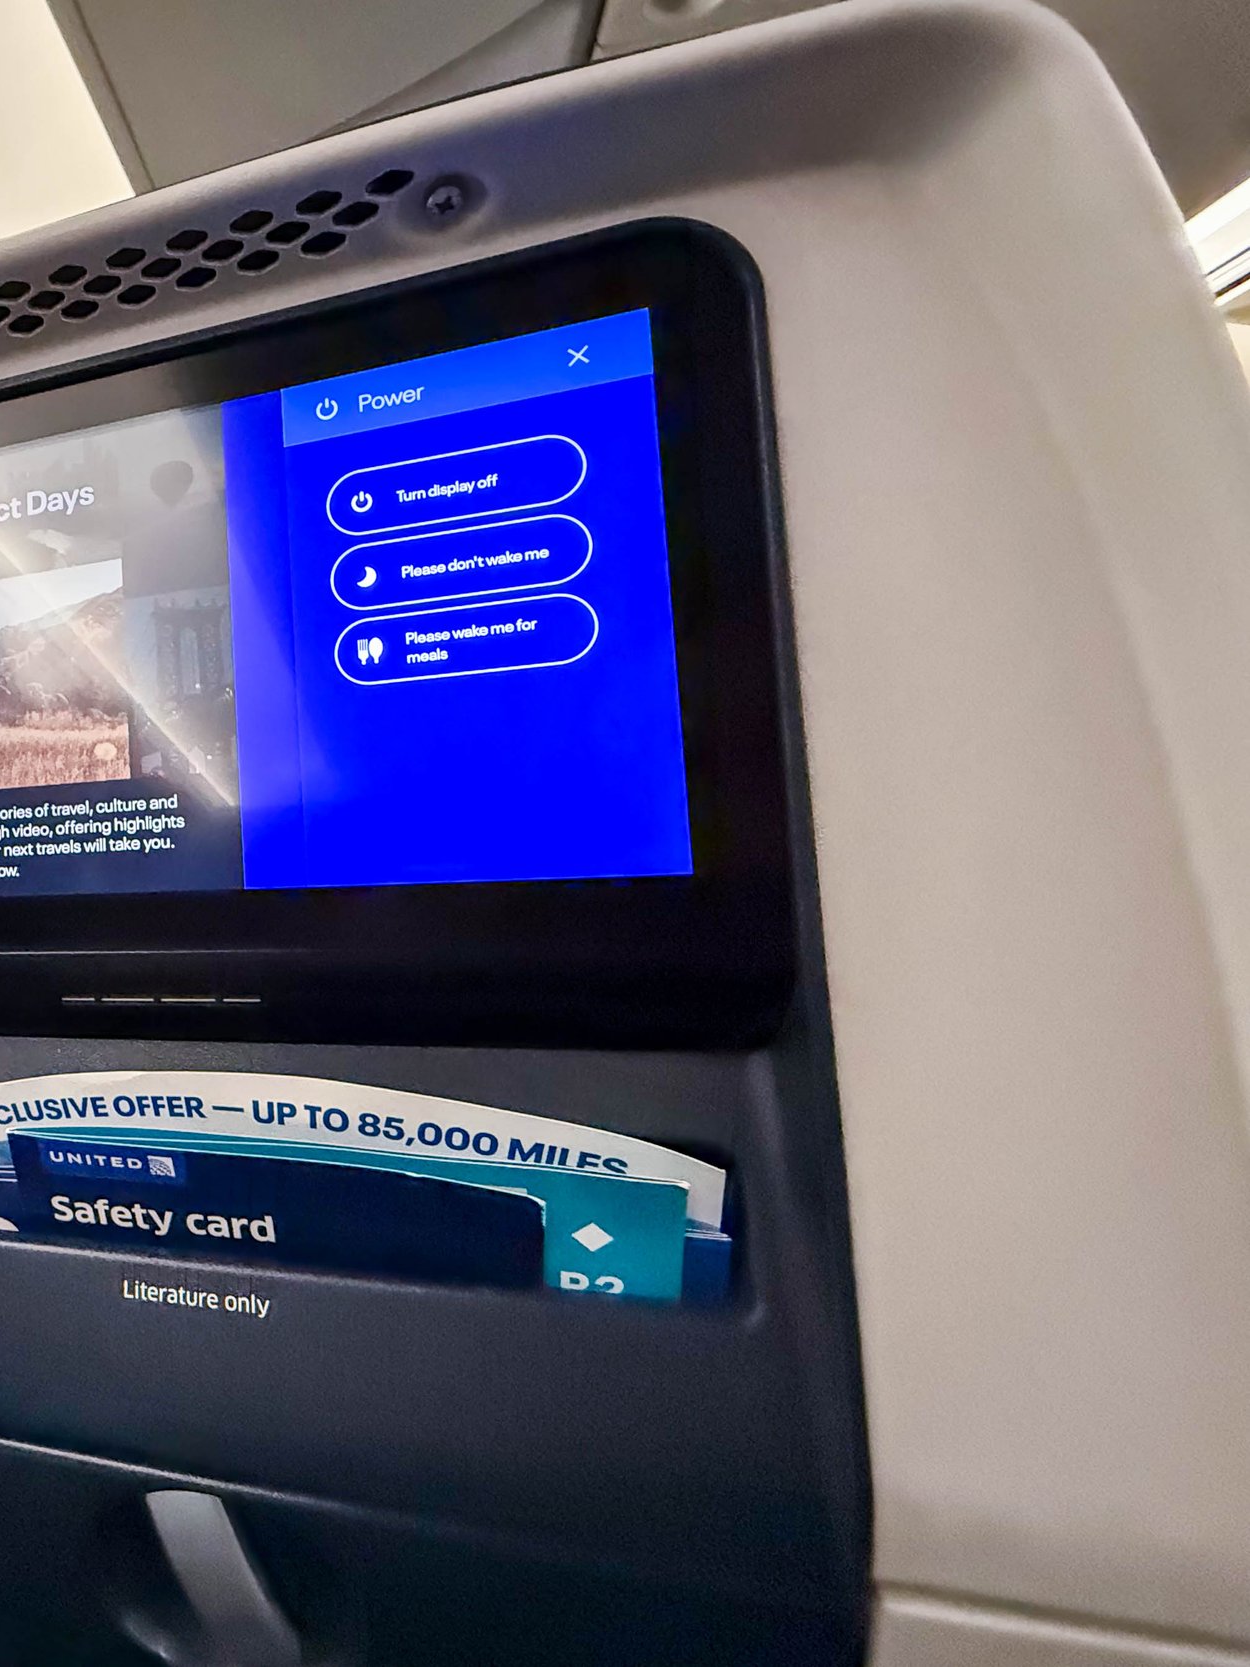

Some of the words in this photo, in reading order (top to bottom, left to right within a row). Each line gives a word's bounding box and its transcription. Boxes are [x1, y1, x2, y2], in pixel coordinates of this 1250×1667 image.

[358, 385, 425, 412] Power
[26, 486, 95, 516] Days
[396, 488, 427, 502] Turn
[427, 480, 476, 500] display
[478, 473, 499, 491] off
[401, 562, 447, 578] Please
[448, 554, 485, 572] don't
[485, 551, 523, 566] wake
[524, 548, 550, 561] me
[405, 628, 451, 645] Please
[452, 622, 489, 638] wake
[490, 621, 515, 634] me
[516, 618, 538, 632] for
[406, 649, 448, 664] meals
[34, 802, 50, 818] of
[51, 799, 94, 817] travel,
[95, 798, 147, 814] culture
[149, 793, 179, 810] and
[12, 821, 54, 839] video,
[55, 818, 112, 836] offering
[113, 814, 186, 835] highlights
[3, 842, 35, 857] next
[35, 839, 82, 856] travels
[83, 836, 107, 853] will
[108, 835, 141, 852] take
[142, 836, 176, 854] you.
[112, 1094, 206, 1120] OFFER
[251, 1099, 298, 1126] UP
[303, 1104, 349, 1132] TO
[357, 1112, 500, 1157] 85,000
[49, 1150, 143, 1171] UNITED
[49, 1194, 174, 1238] Safety
[185, 1213, 276, 1243] card
[122, 1279, 220, 1311] Literature
[223, 1292, 270, 1318] only
